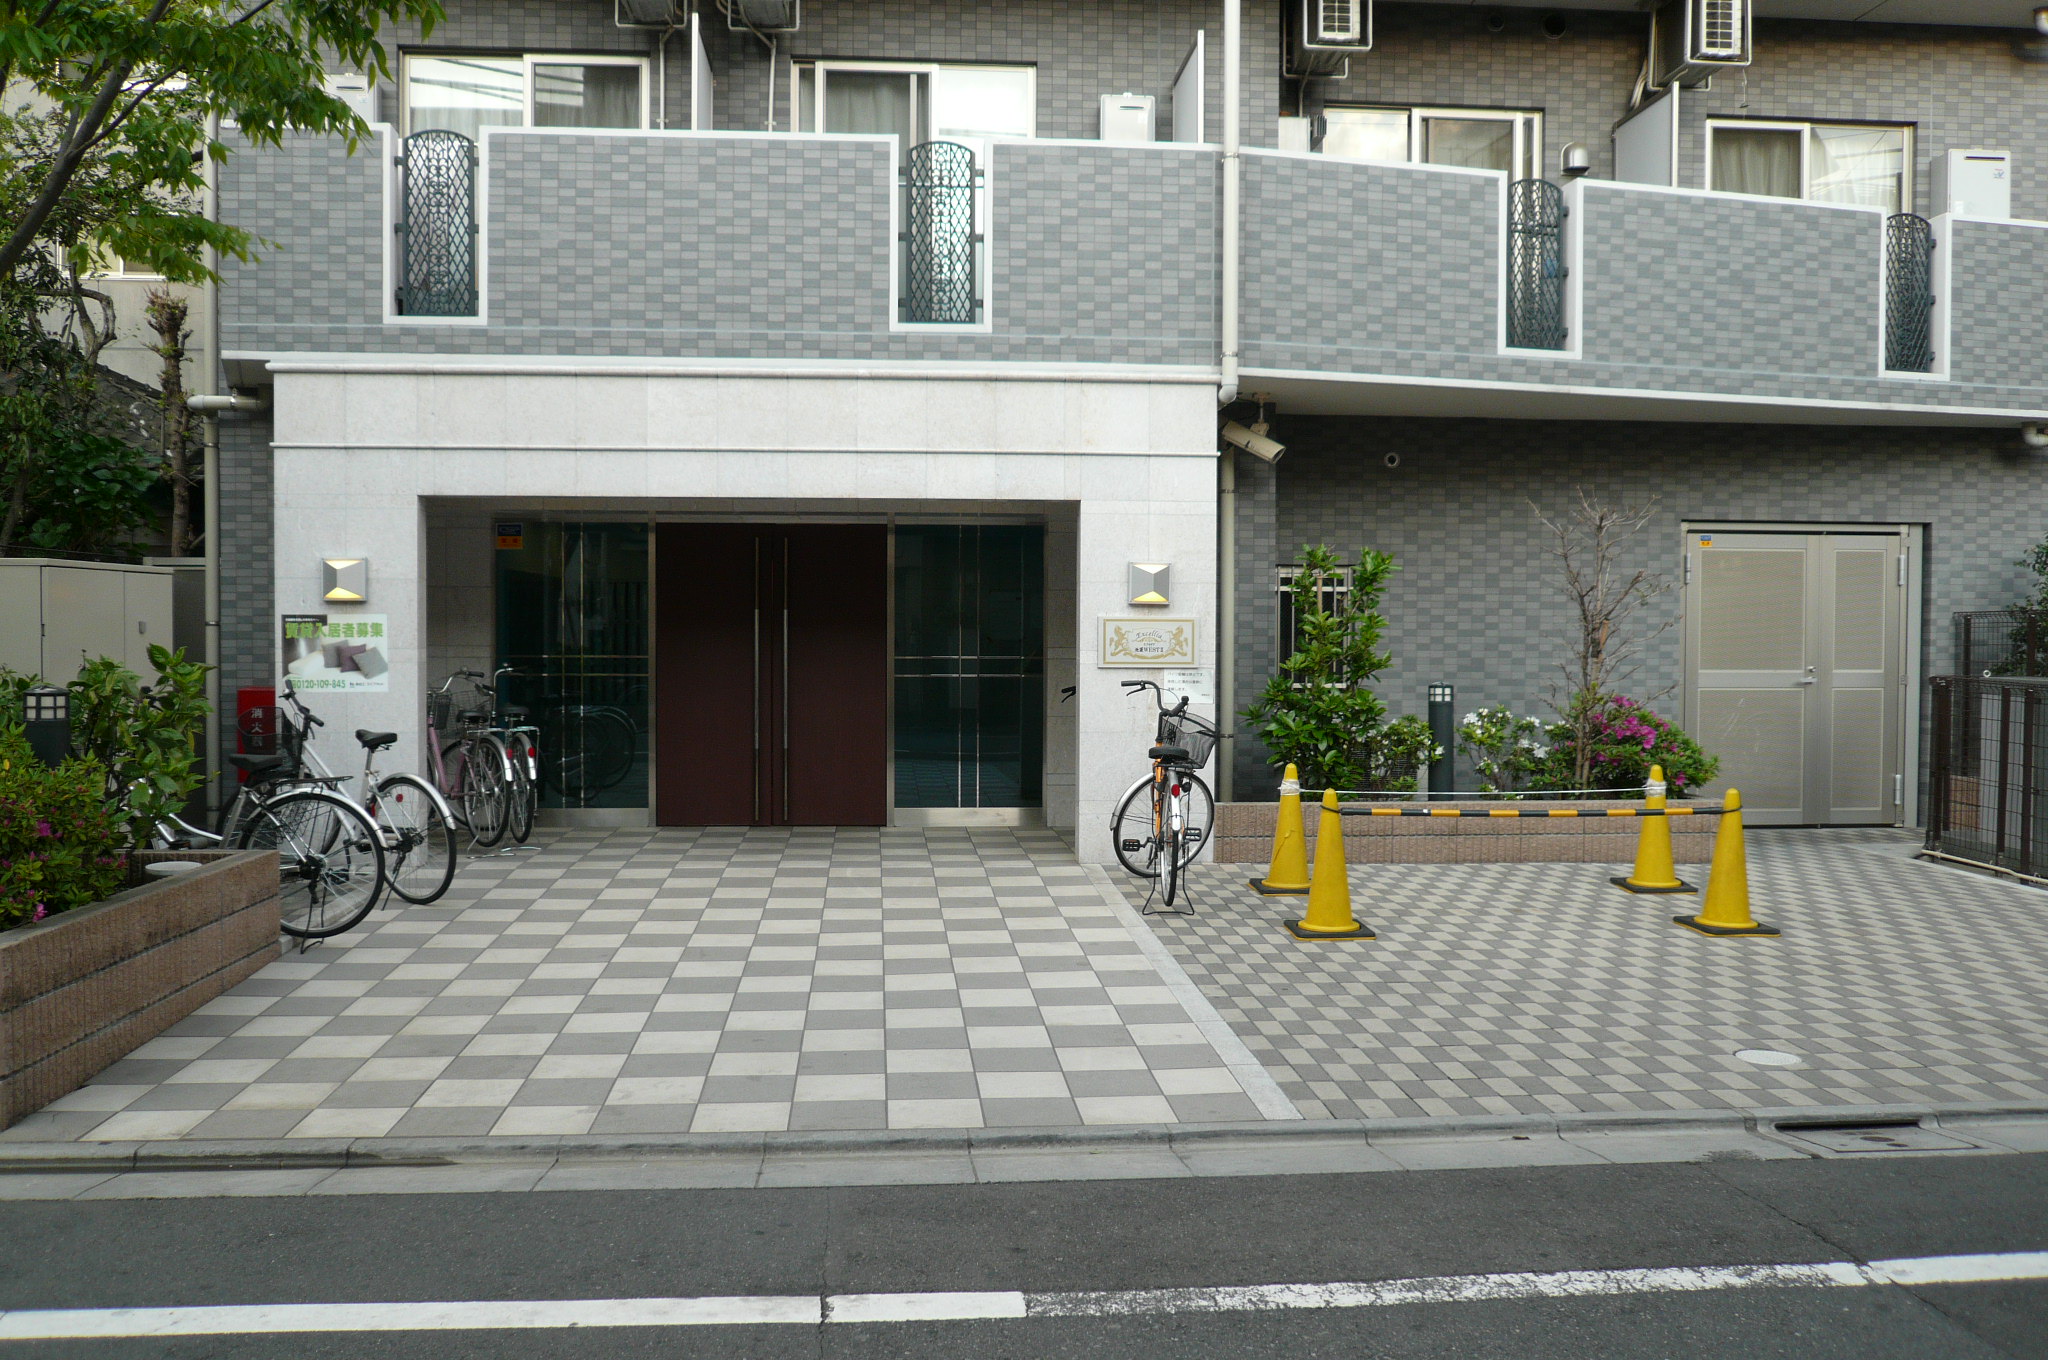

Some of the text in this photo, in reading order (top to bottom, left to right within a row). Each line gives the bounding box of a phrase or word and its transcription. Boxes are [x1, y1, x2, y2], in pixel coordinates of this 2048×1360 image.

[285, 622, 383, 639] 賃貸入居者募集
[297, 679, 346, 689] 0120-109-845
